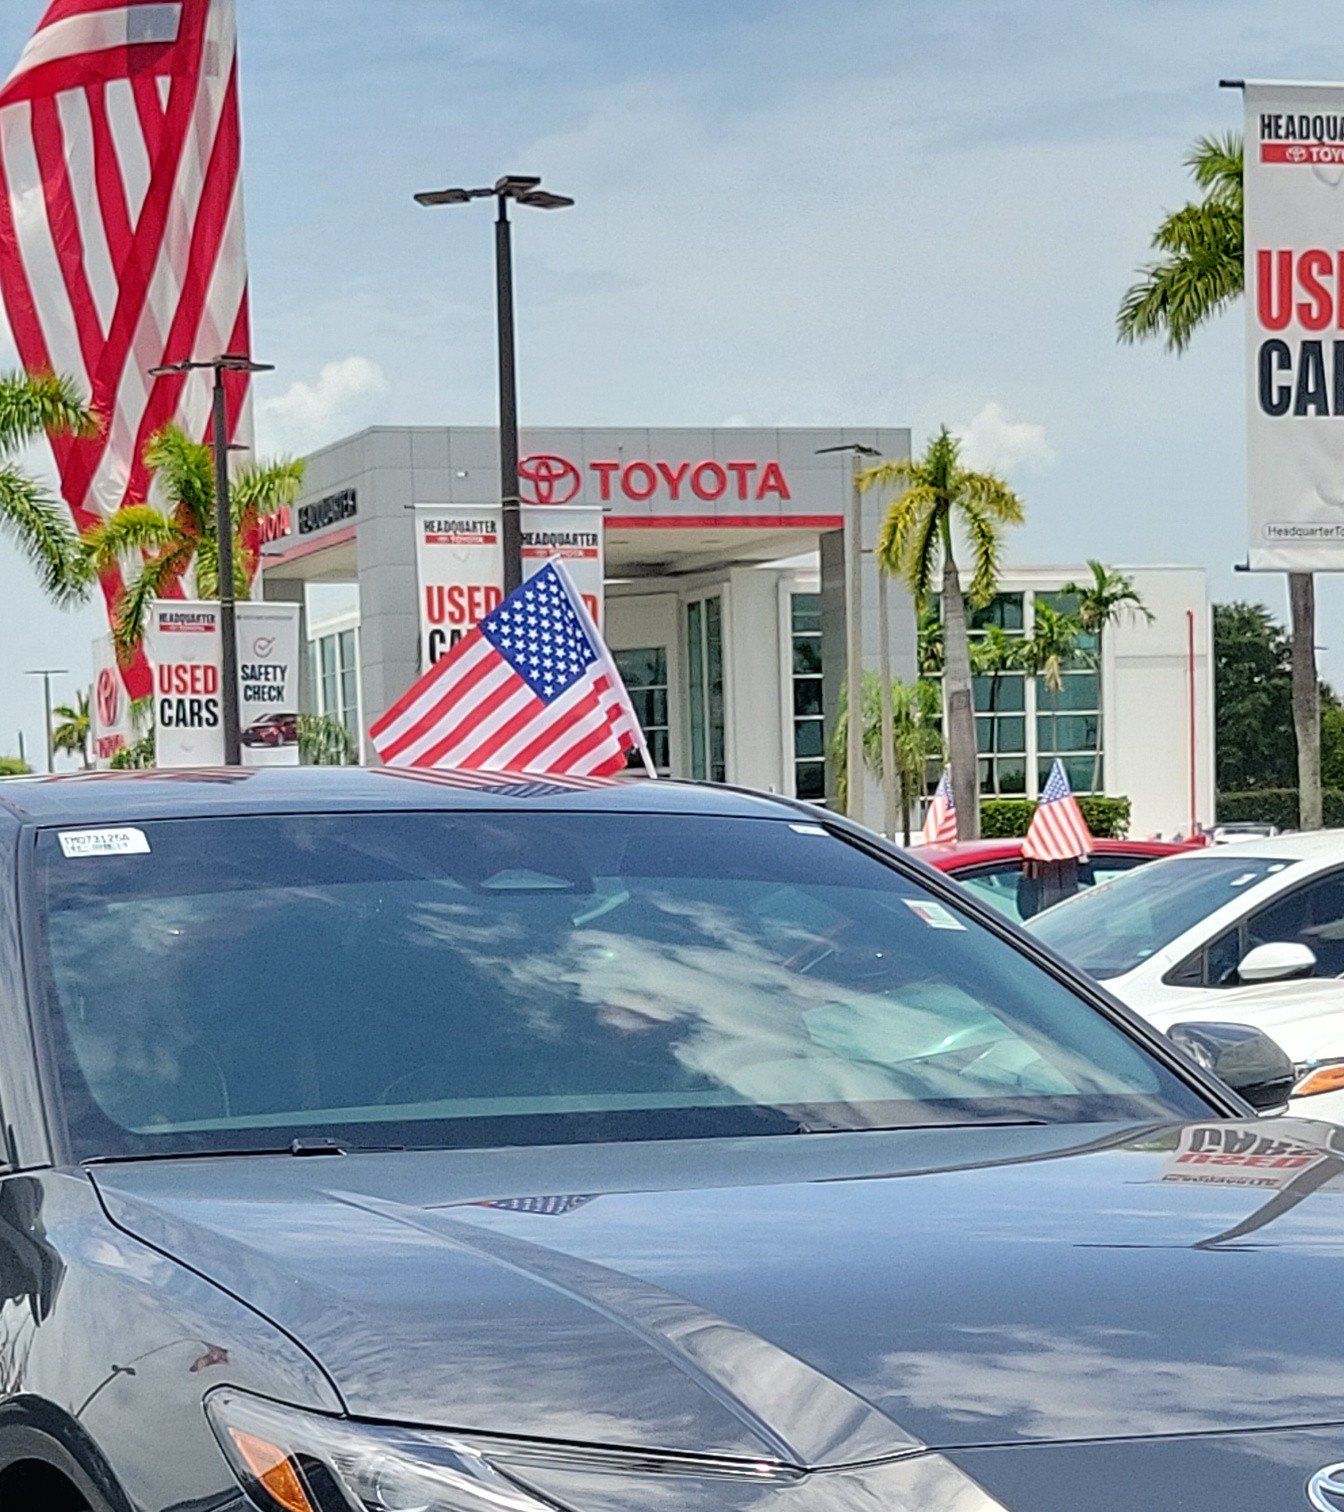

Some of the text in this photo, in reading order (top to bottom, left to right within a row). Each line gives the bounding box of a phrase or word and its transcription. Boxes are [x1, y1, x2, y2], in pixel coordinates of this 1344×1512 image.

[589, 460, 791, 500] TOYOTA
[426, 586, 502, 624] USED
[159, 664, 218, 695] USED
[241, 664, 287, 682] SAFETY
[243, 685, 285, 702] CHECK
[160, 698, 218, 727] CARS
